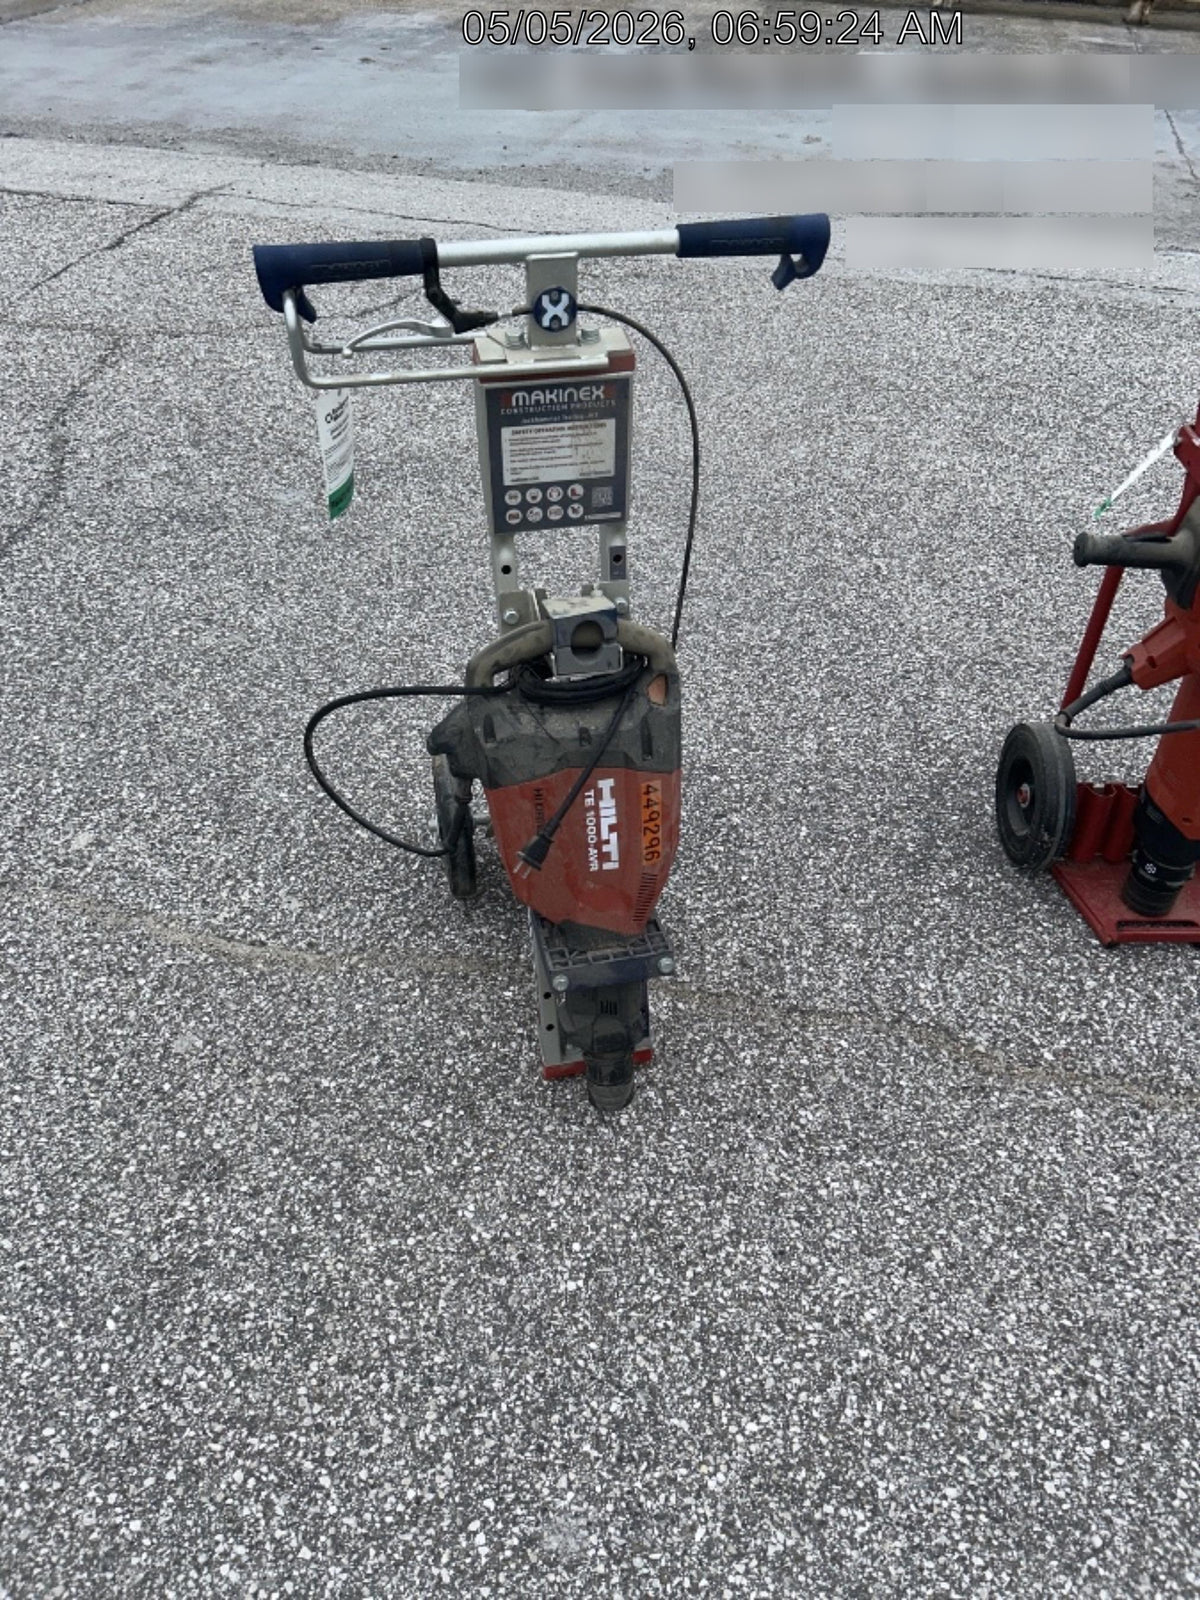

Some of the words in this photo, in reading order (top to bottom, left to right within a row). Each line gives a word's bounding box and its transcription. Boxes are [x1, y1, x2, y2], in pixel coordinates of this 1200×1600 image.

[501, 404, 568, 415] CONSTRUCTION
[570, 400, 616, 411] PRODUCTS
[511, 385, 605, 407] MAKINEX
[584, 789, 595, 808] TE
[586, 811, 598, 872] 1000-AVR
[597, 778, 620, 870] HILTI
[642, 783, 661, 862] 449296
